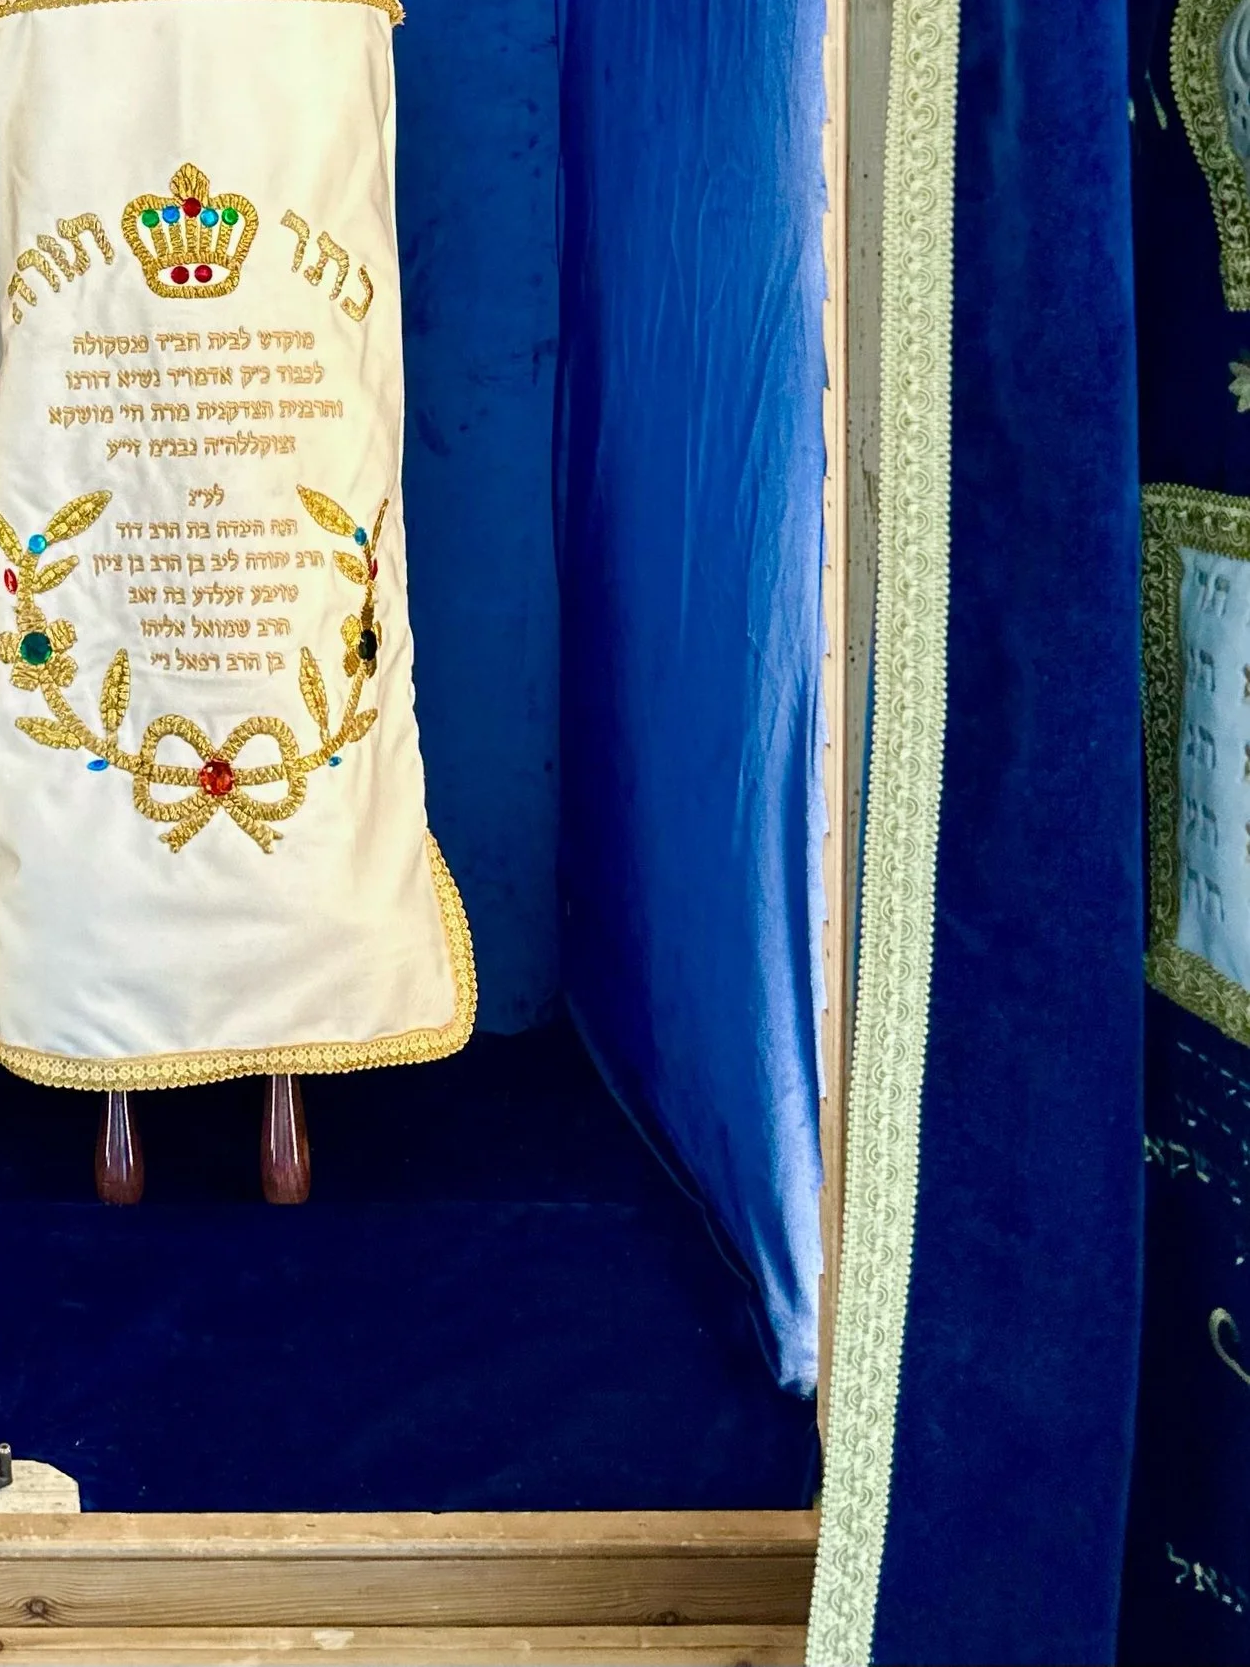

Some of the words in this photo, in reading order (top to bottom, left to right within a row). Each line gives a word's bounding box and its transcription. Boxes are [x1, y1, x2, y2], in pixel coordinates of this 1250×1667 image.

[8, 212, 114, 325] תורה
[280, 209, 373, 322] כתר
[207, 325, 251, 351] לבית
[117, 368, 161, 389] נשיא
